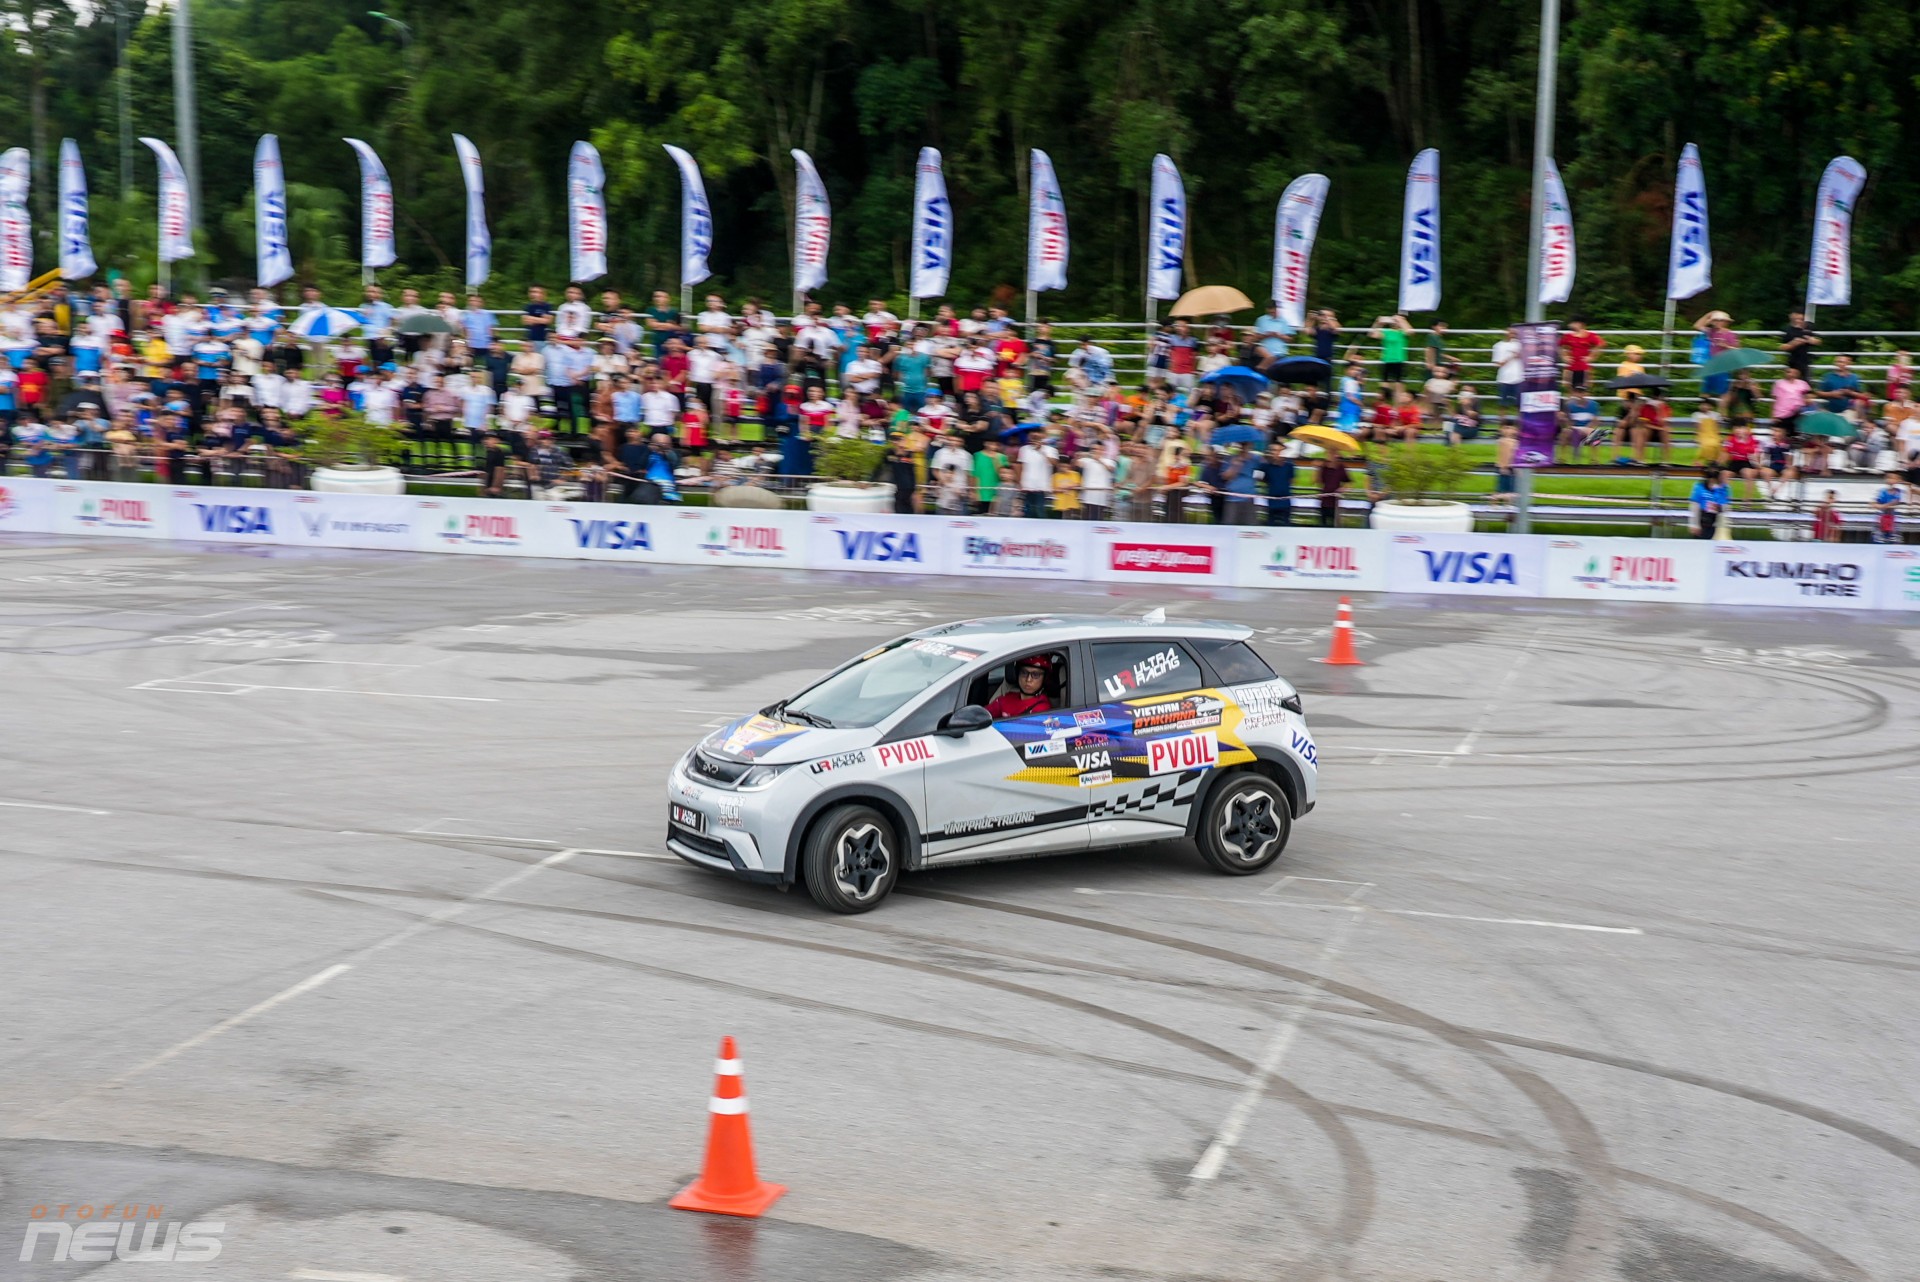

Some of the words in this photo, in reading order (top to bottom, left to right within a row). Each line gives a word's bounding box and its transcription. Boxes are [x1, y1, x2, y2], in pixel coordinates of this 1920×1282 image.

[924, 197, 948, 270] VISA
[1157, 196, 1183, 271] VISA
[1678, 191, 1701, 269] VISA
[1409, 207, 1434, 286] VISA
[192, 503, 273, 535] VISA
[567, 518, 653, 552] VISA
[831, 528, 925, 563] VISA
[1416, 549, 1517, 585] VISA
[1610, 555, 1679, 583] PVOIL
[1726, 559, 1862, 582] KUMHO
[1796, 582, 1860, 597] TIRE
[1133, 648, 1180, 675] ULTRA
[1136, 657, 1182, 687] RACING
[1133, 702, 1180, 718] VIETNAM
[1134, 723, 1177, 736] CHAMPIONSHIP
[878, 739, 935, 767] PVOIL
[1071, 750, 1112, 770] VISA
[1151, 734, 1215, 771] PVOIL
